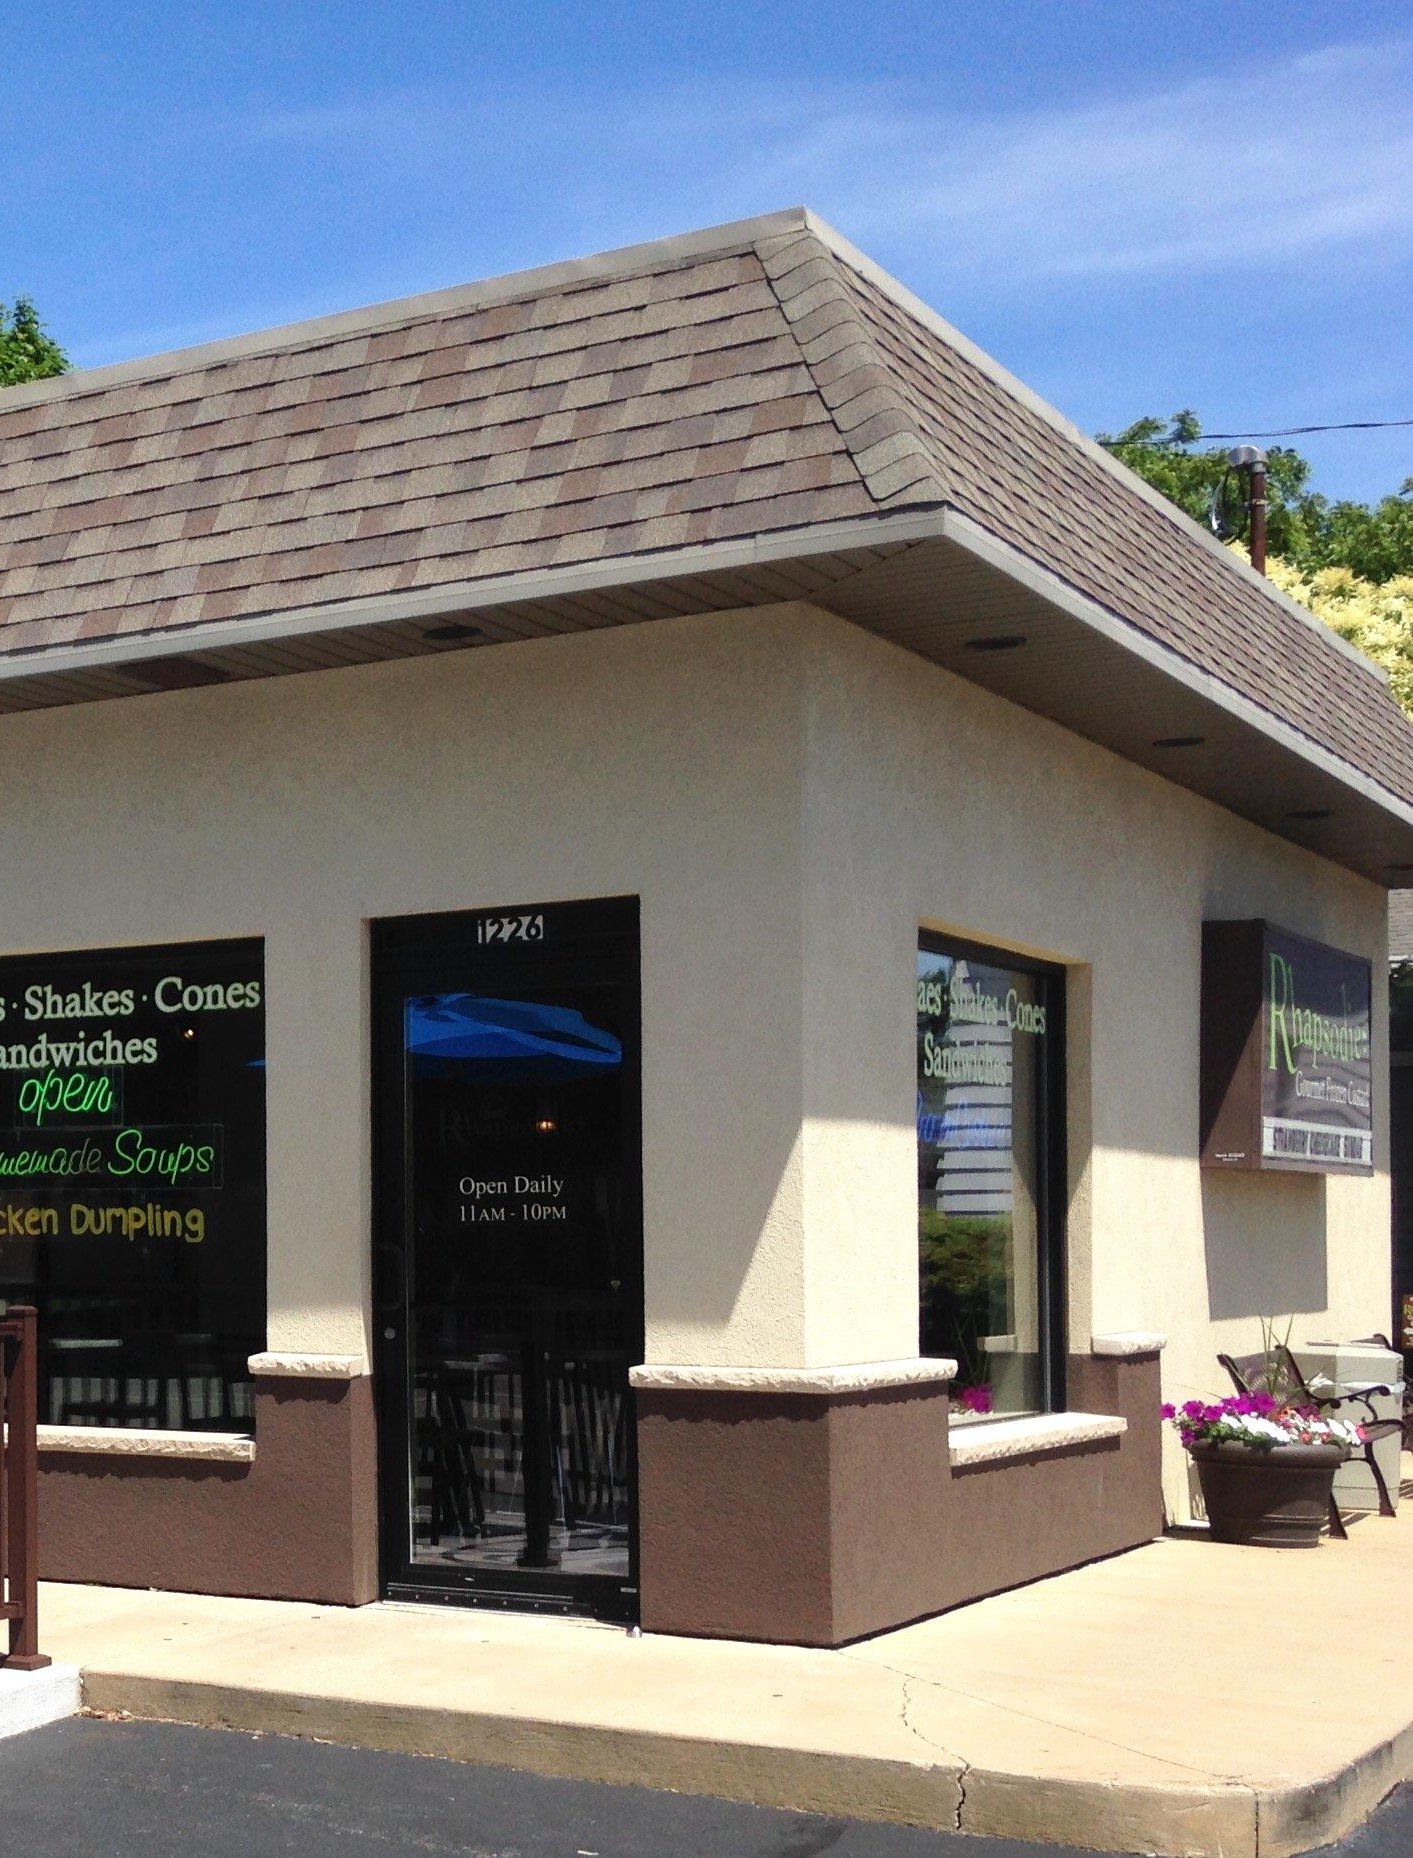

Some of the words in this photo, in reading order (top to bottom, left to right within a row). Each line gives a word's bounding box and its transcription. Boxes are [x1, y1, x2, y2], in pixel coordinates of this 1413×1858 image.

[479, 916, 544, 943] 1226
[24, 980, 135, 1020] Shakes
[154, 976, 261, 1013] Cones
[1005, 988, 1046, 1035] Cones
[18, 1069, 113, 1126] open
[108, 1129, 215, 1185] Soups
[459, 1177, 508, 1199] Open
[514, 1175, 564, 1197] Daily
[459, 1205, 505, 1222] 11AM
[522, 1203, 567, 1221] 10PM
